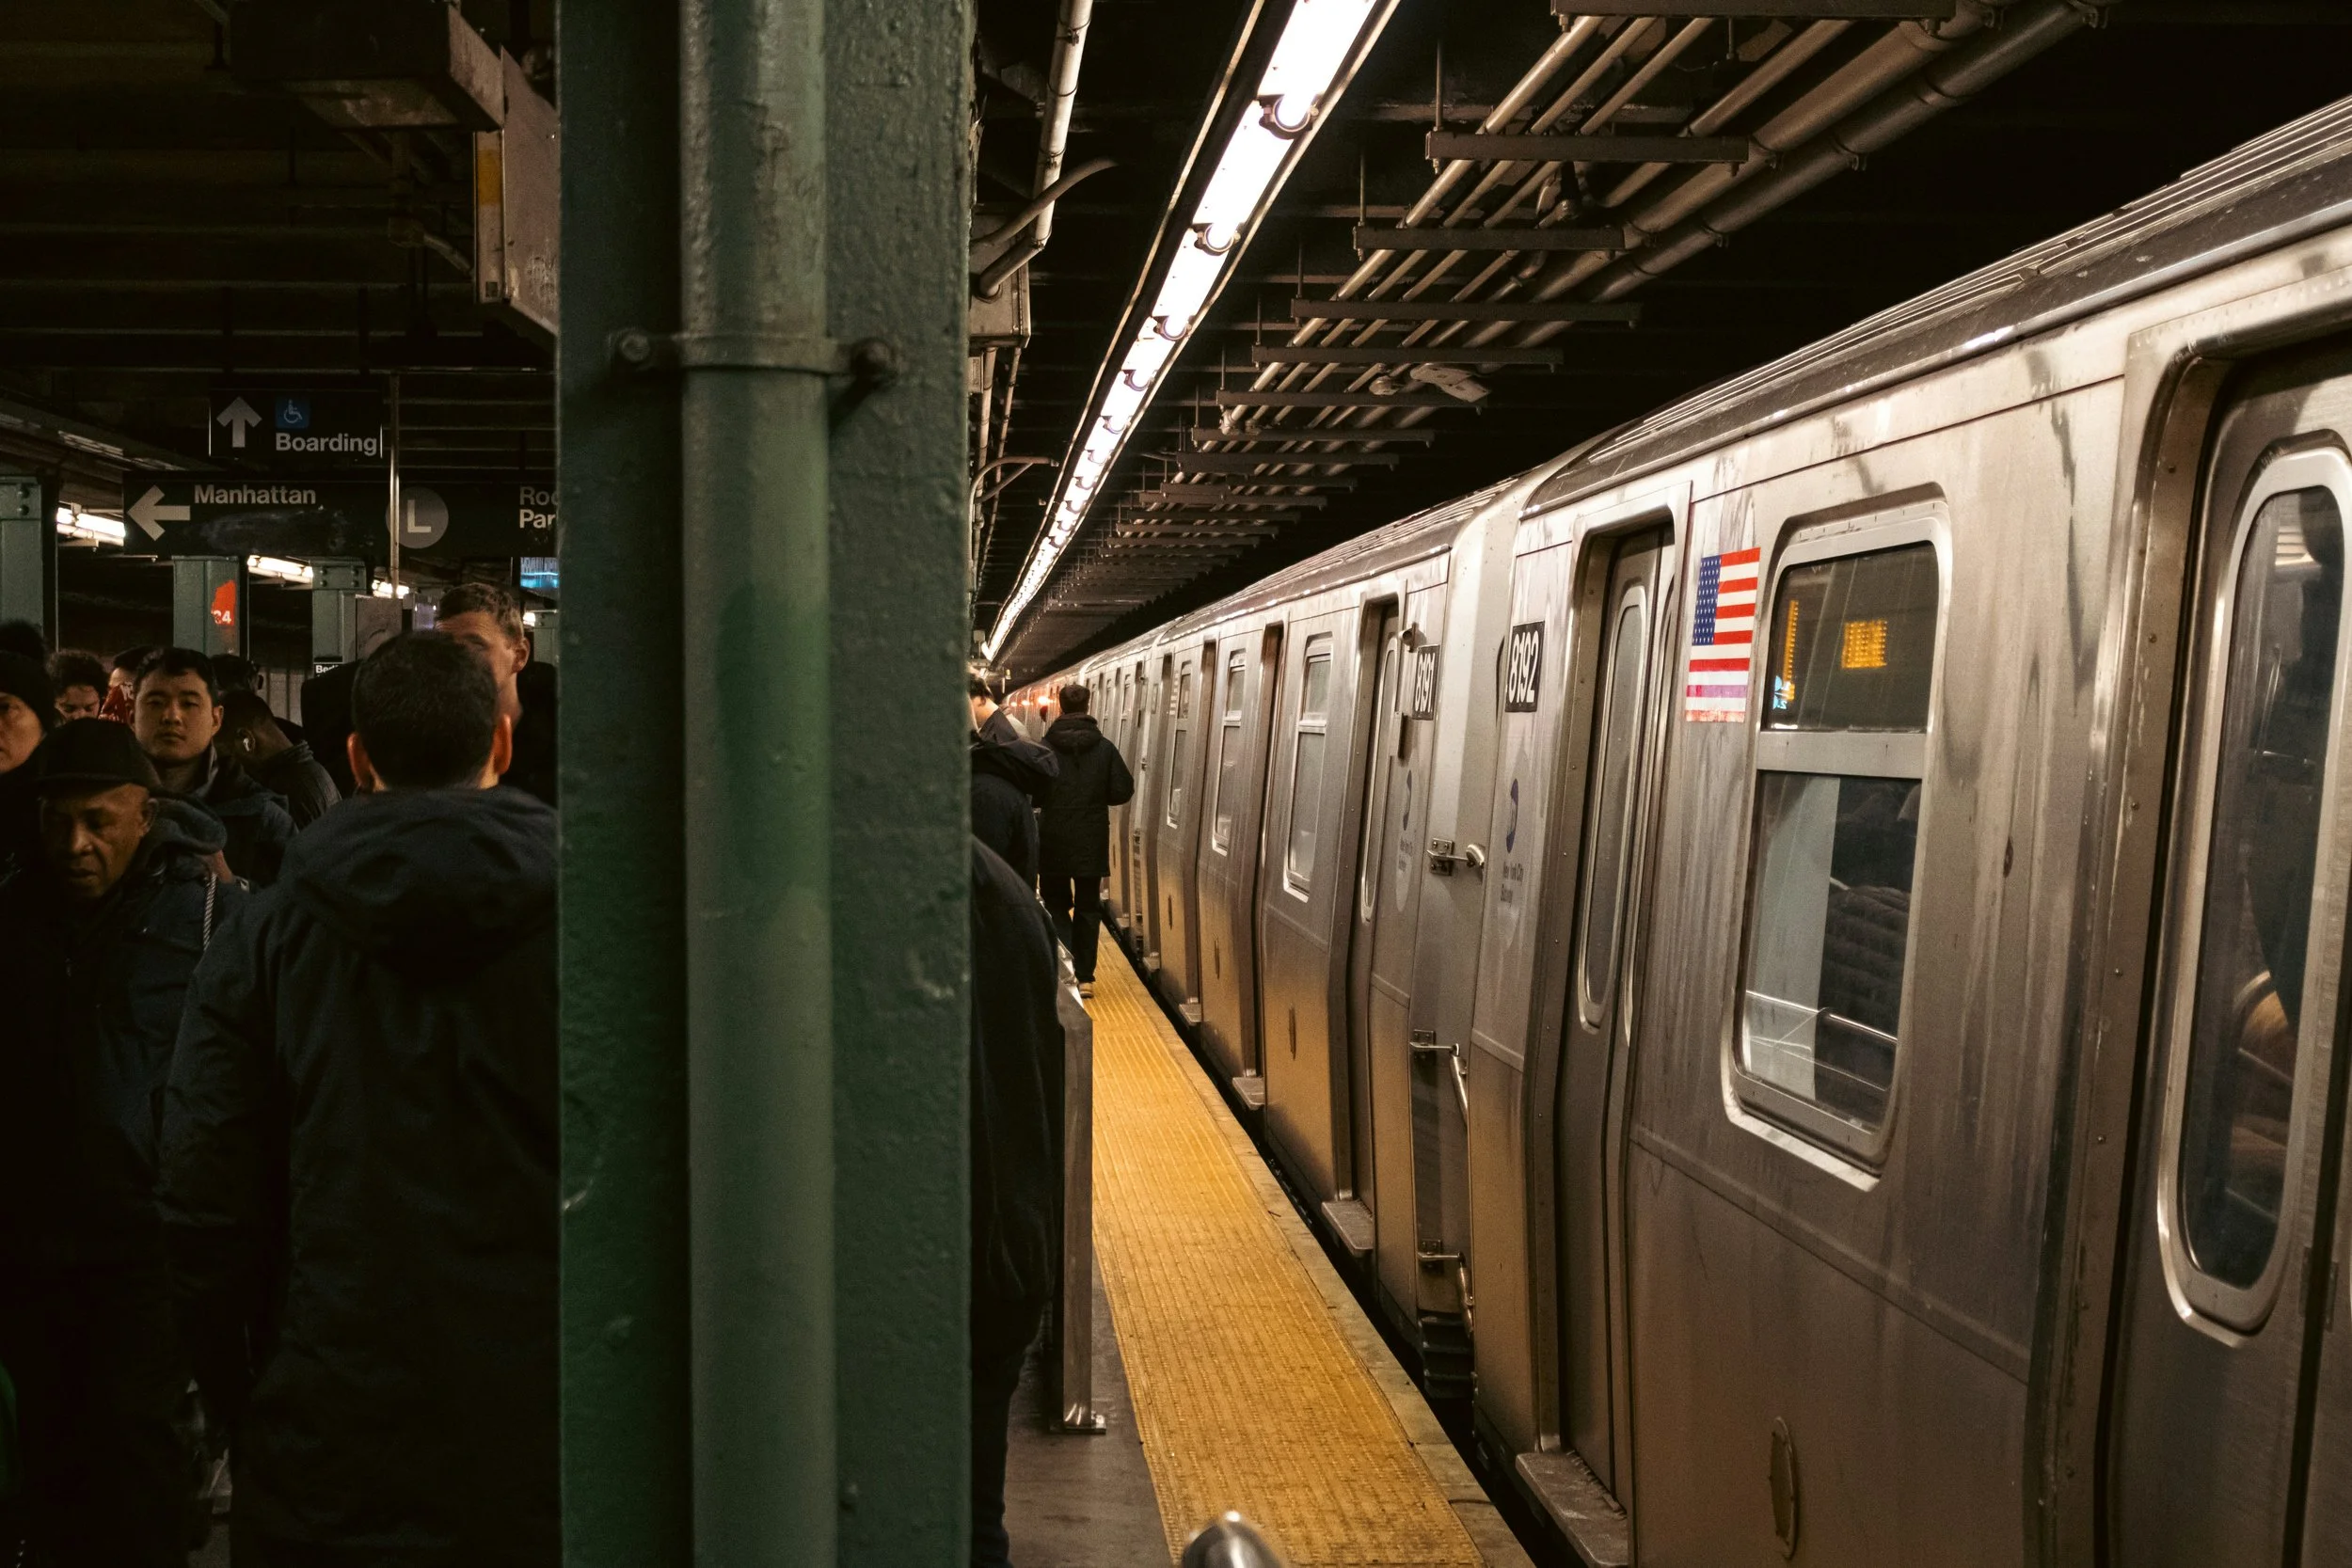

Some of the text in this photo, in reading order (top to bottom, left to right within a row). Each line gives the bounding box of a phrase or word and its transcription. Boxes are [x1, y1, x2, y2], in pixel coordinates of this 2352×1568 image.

[275, 432, 377, 457] Boarding
[194, 483, 316, 505] Manhattan
[406, 499, 432, 533] L
[1414, 652, 1436, 713] 8191
[1508, 630, 1539, 704] 8192
